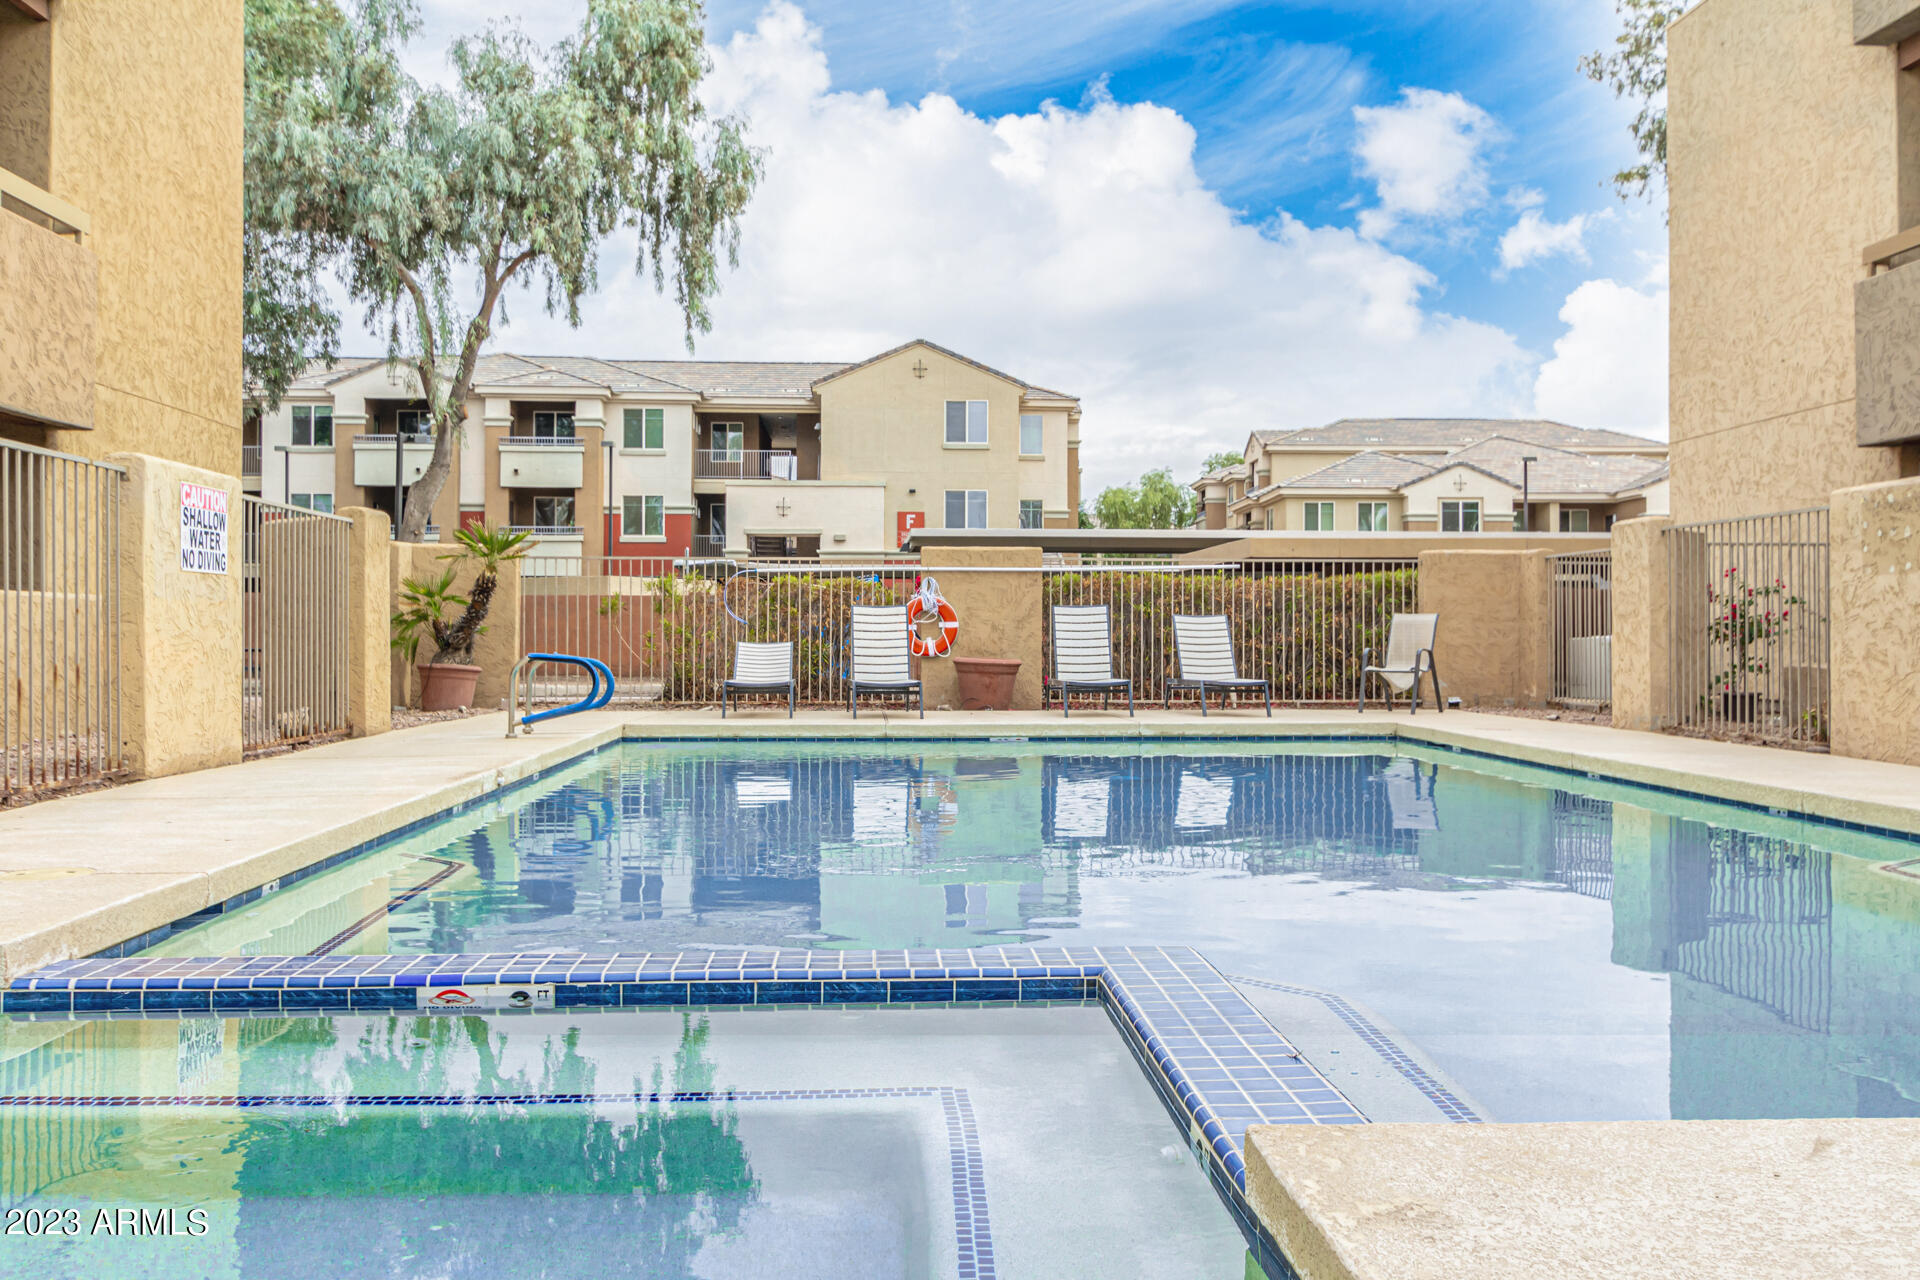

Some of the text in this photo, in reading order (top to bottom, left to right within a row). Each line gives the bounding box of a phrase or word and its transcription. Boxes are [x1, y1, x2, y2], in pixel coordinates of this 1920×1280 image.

[183, 485, 227, 512] CAUTION
[183, 506, 226, 532] SHALLOW
[906, 514, 916, 529] F
[189, 528, 221, 551] WATER
[182, 548, 226, 572] NO DIVING
